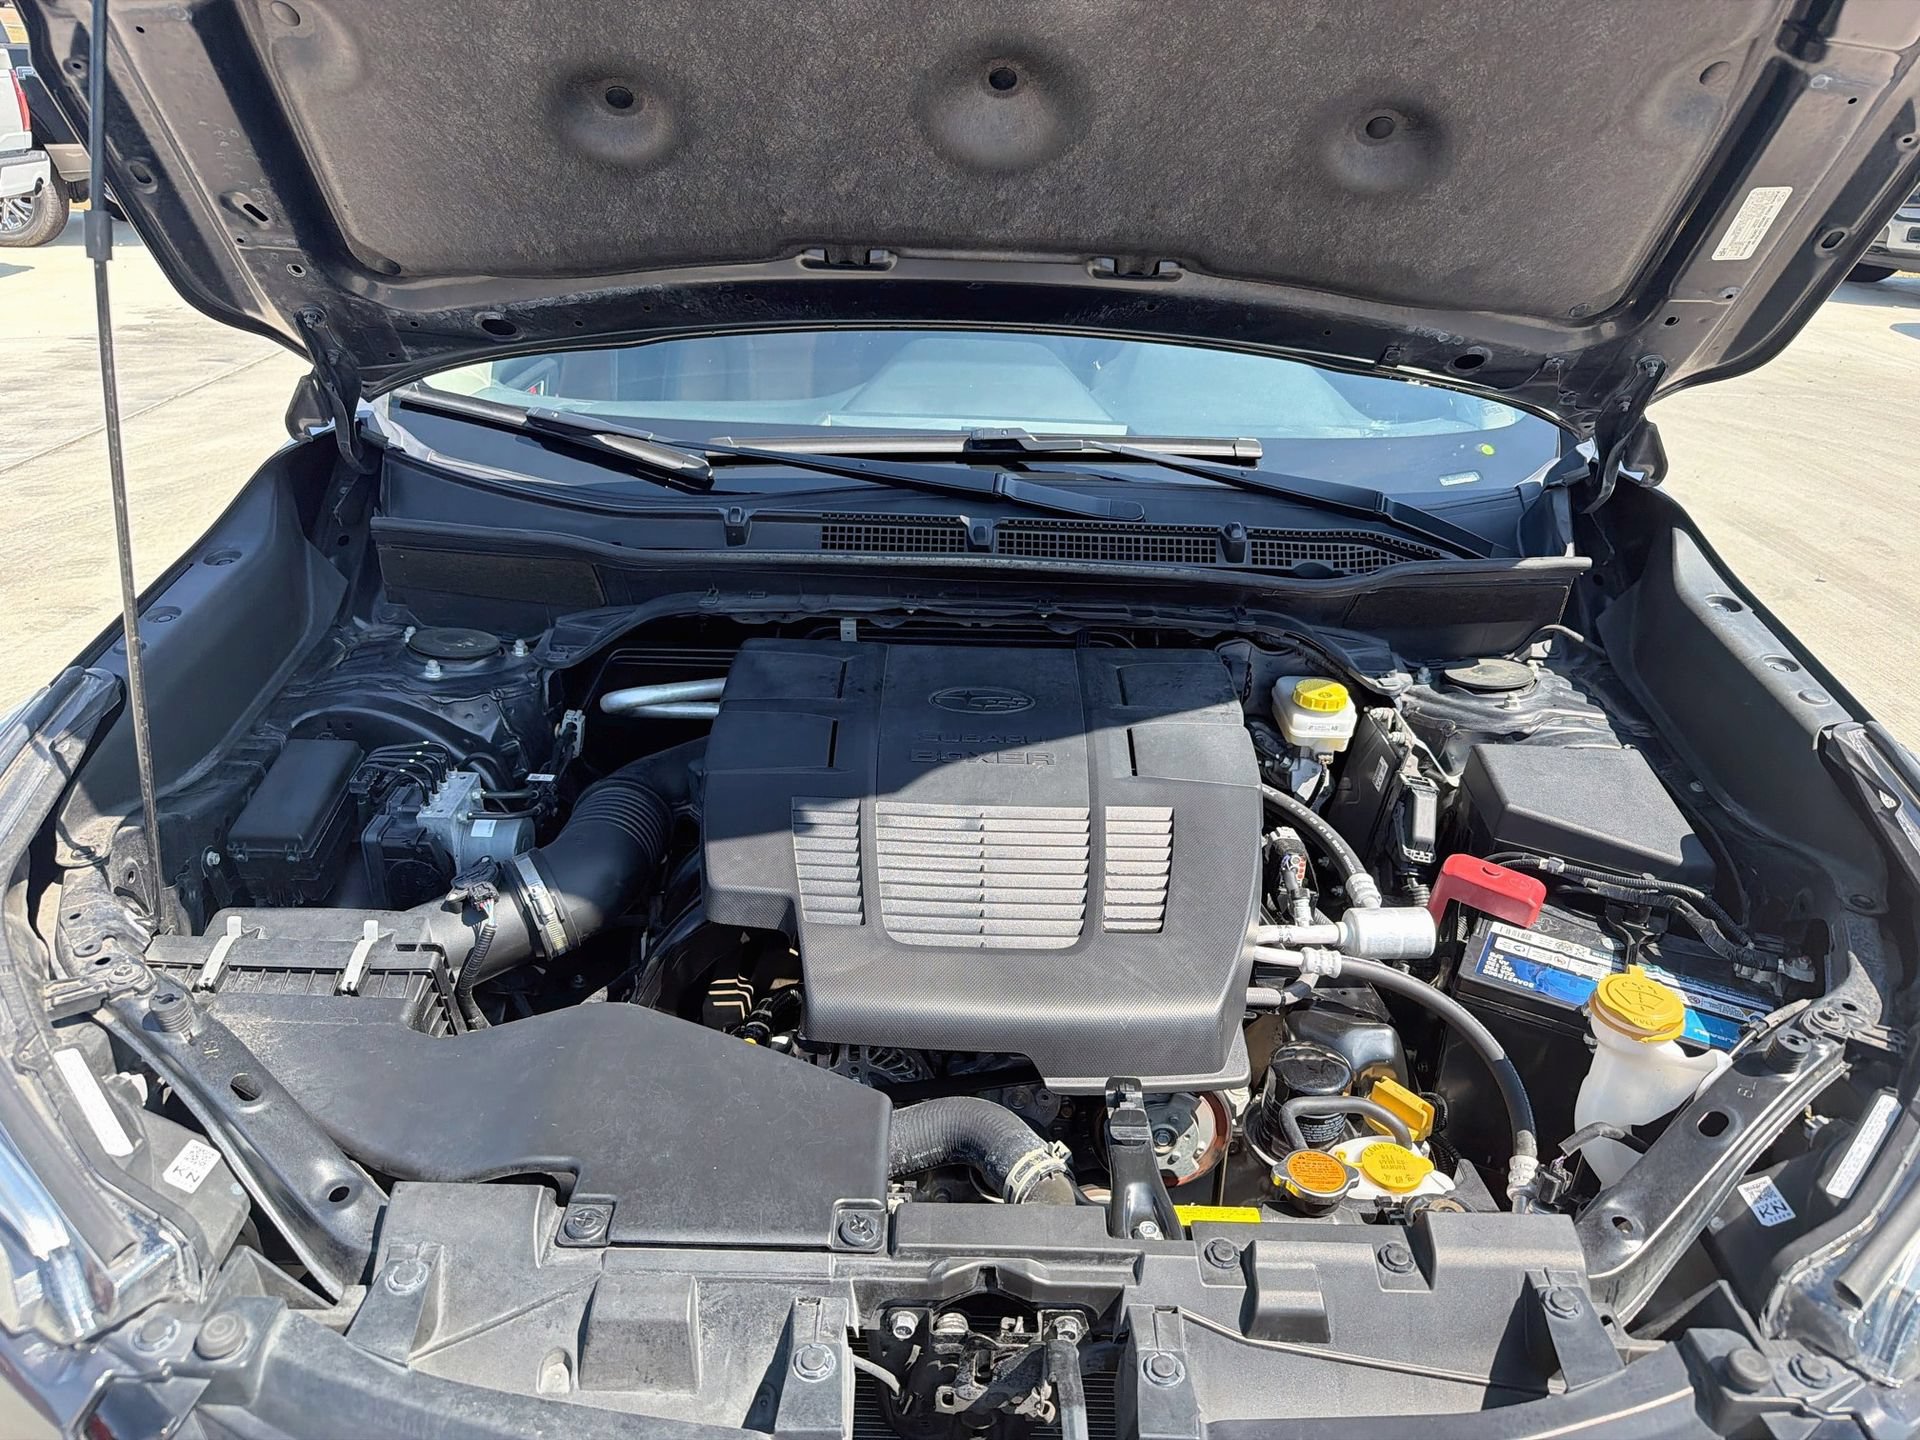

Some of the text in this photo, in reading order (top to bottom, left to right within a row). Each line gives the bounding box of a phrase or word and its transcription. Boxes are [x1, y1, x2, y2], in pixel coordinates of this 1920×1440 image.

[916, 730, 1047, 744] SUBARU
[911, 749, 1057, 766] BOXER
[172, 1165, 201, 1183] KN
[1758, 1202, 1788, 1219] KN
